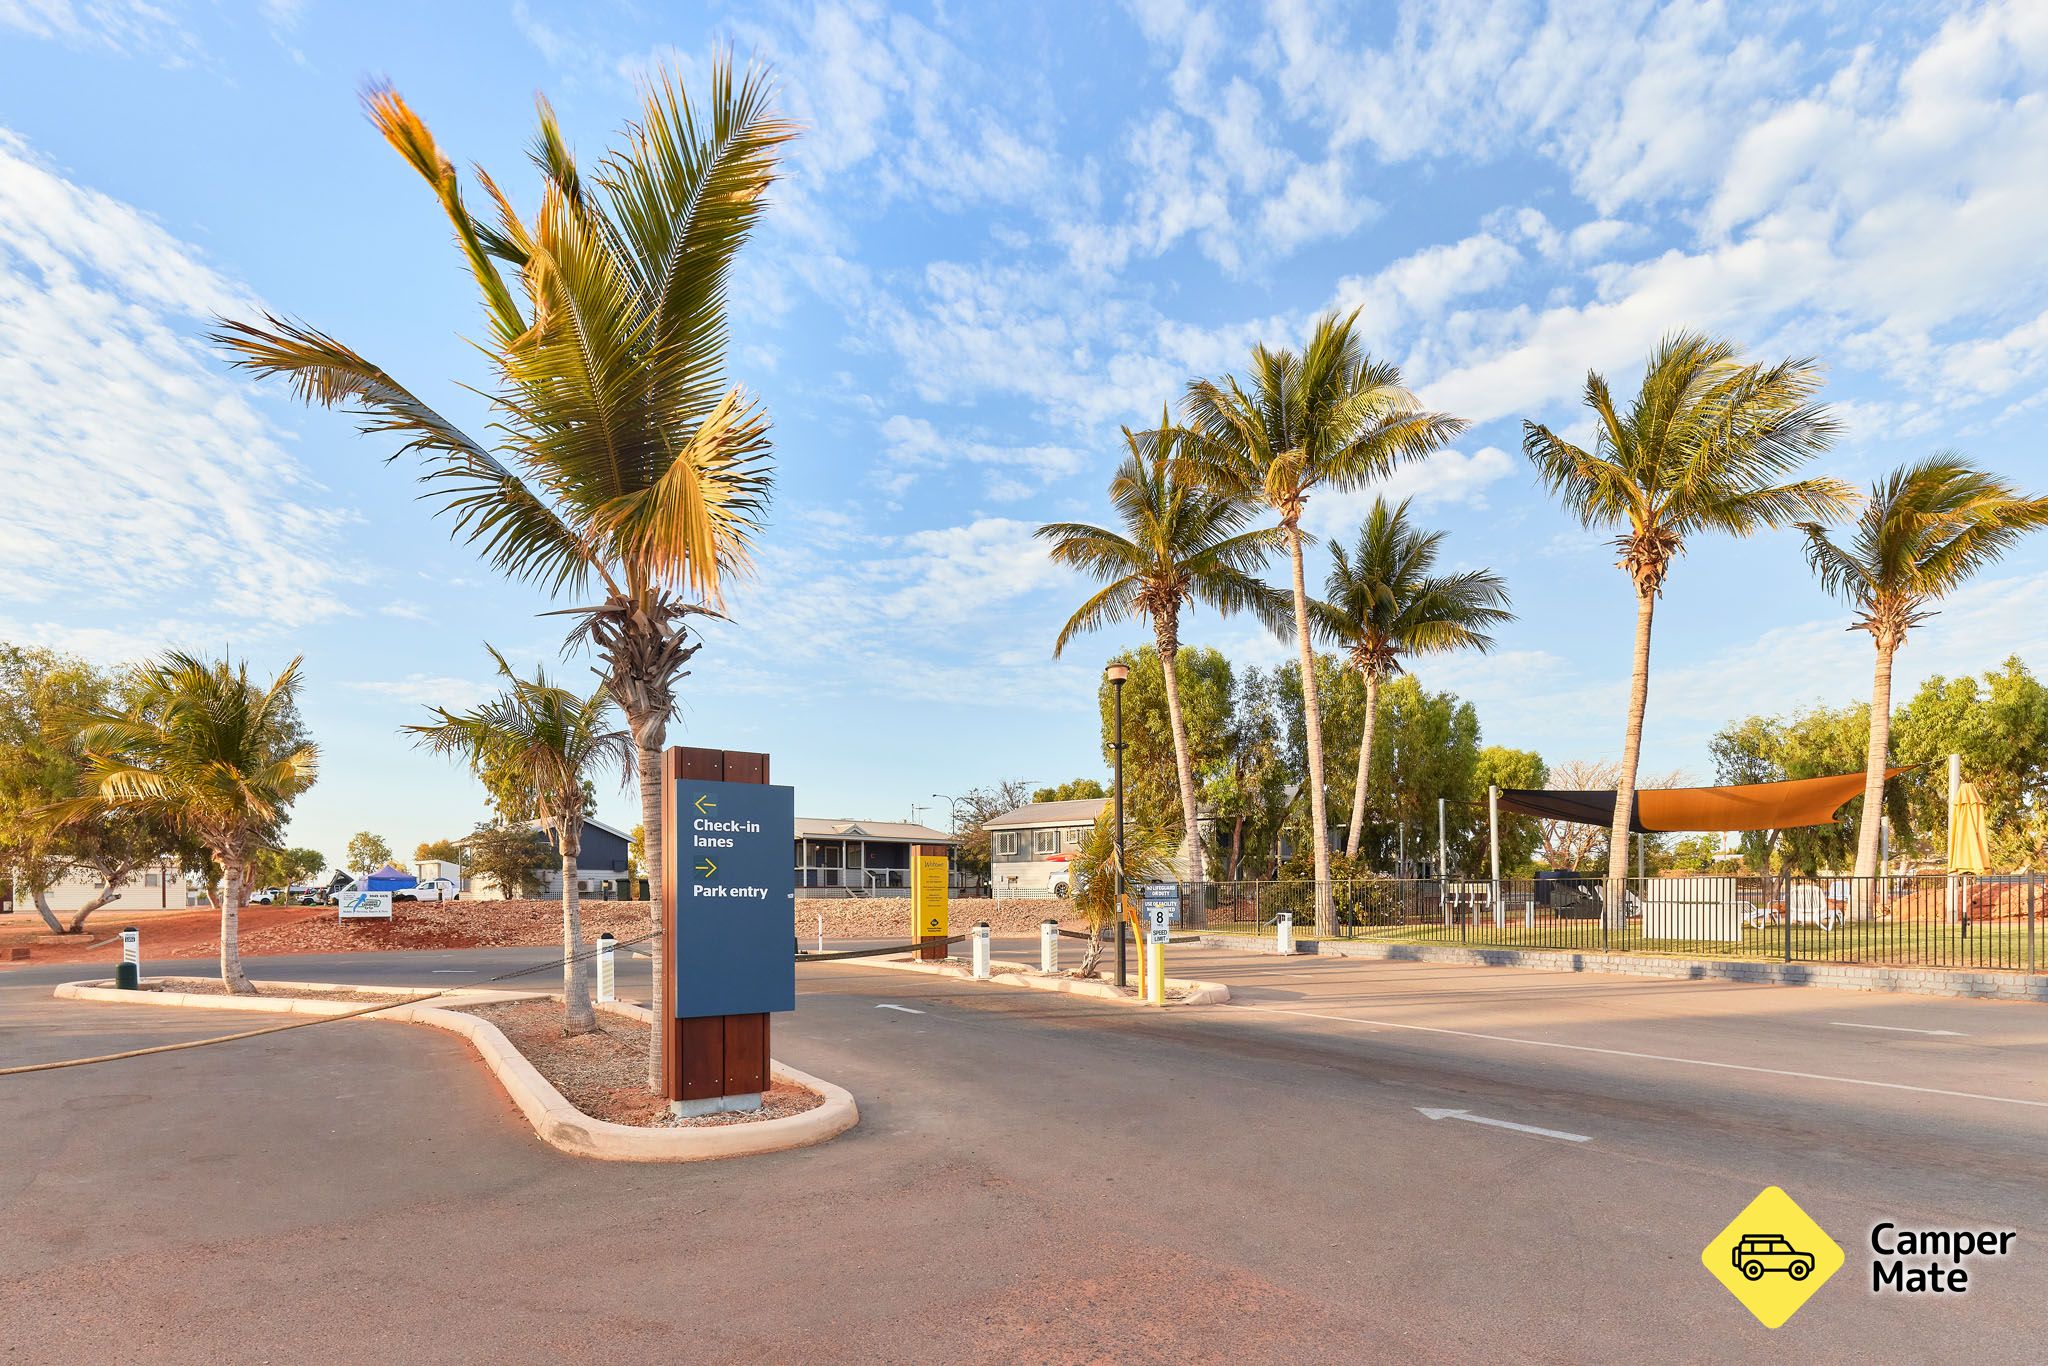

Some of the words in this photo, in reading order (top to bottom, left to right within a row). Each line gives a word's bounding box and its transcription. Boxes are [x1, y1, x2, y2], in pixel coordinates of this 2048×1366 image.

[693, 818, 760, 833] Check-in
[693, 834, 734, 848] lanes
[693, 884, 727, 897] Park
[730, 885, 768, 899] entry
[1156, 911, 1163, 923] 8
